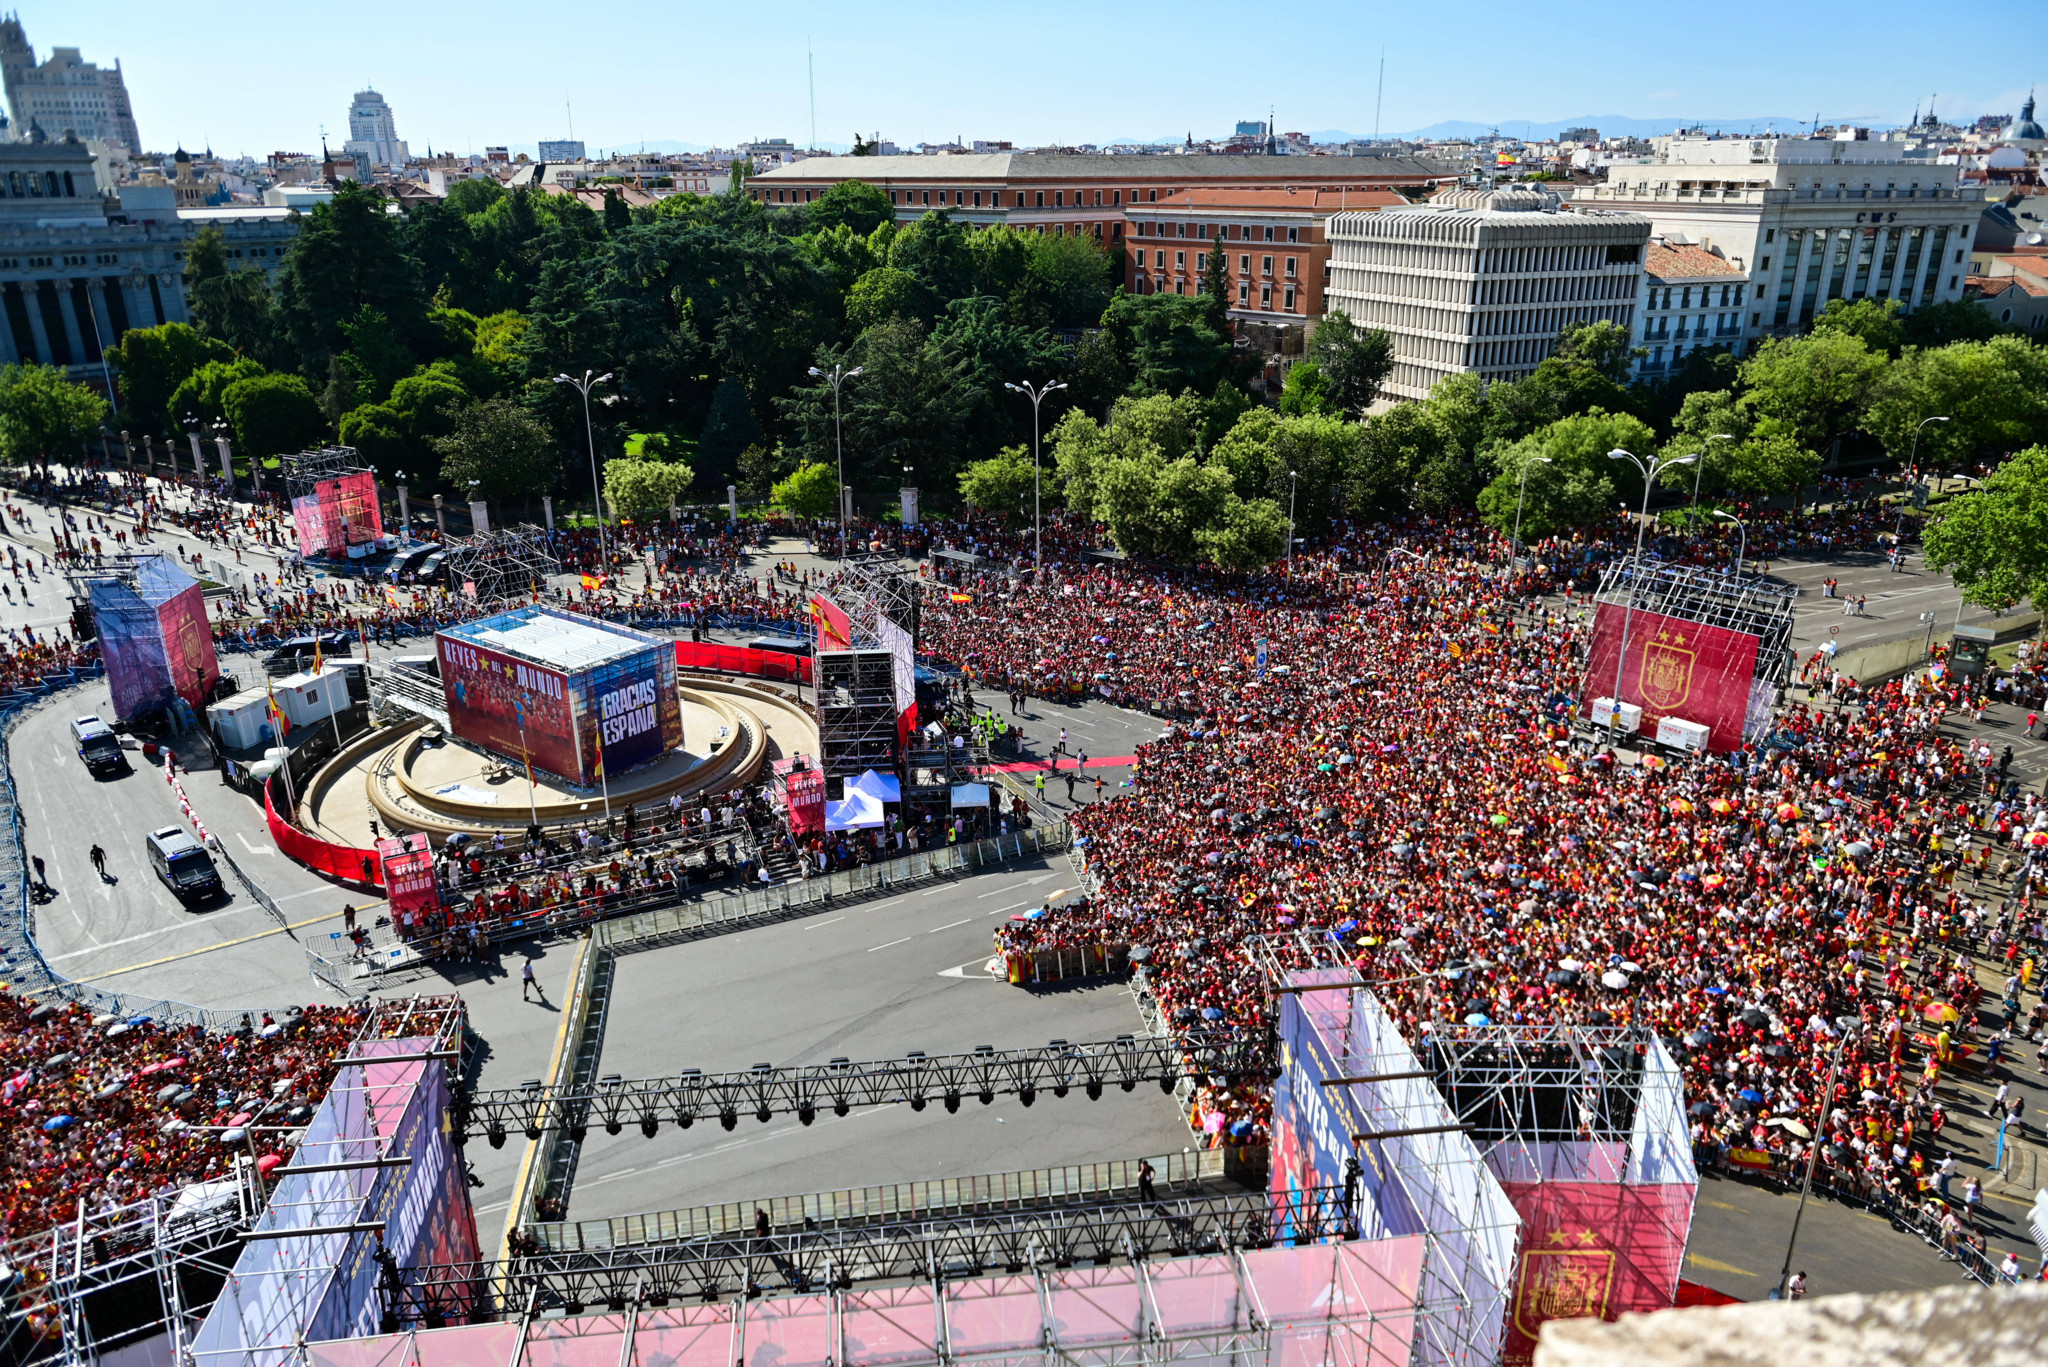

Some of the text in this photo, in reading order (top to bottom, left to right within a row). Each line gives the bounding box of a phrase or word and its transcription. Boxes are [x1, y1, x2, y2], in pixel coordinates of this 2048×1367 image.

[444, 641, 562, 700] REYES DEL MUNDO
[2010, 758, 2048, 774] BUS
[795, 778, 817, 790] REYES
[793, 792, 821, 807] MUNDO
[395, 861, 424, 876] REYES
[394, 876, 431, 894] MUNDO
[1293, 1056, 1328, 1151] REYES
[1328, 1128, 1340, 1167] DEL
[399, 1126, 444, 1258] MUNDO
